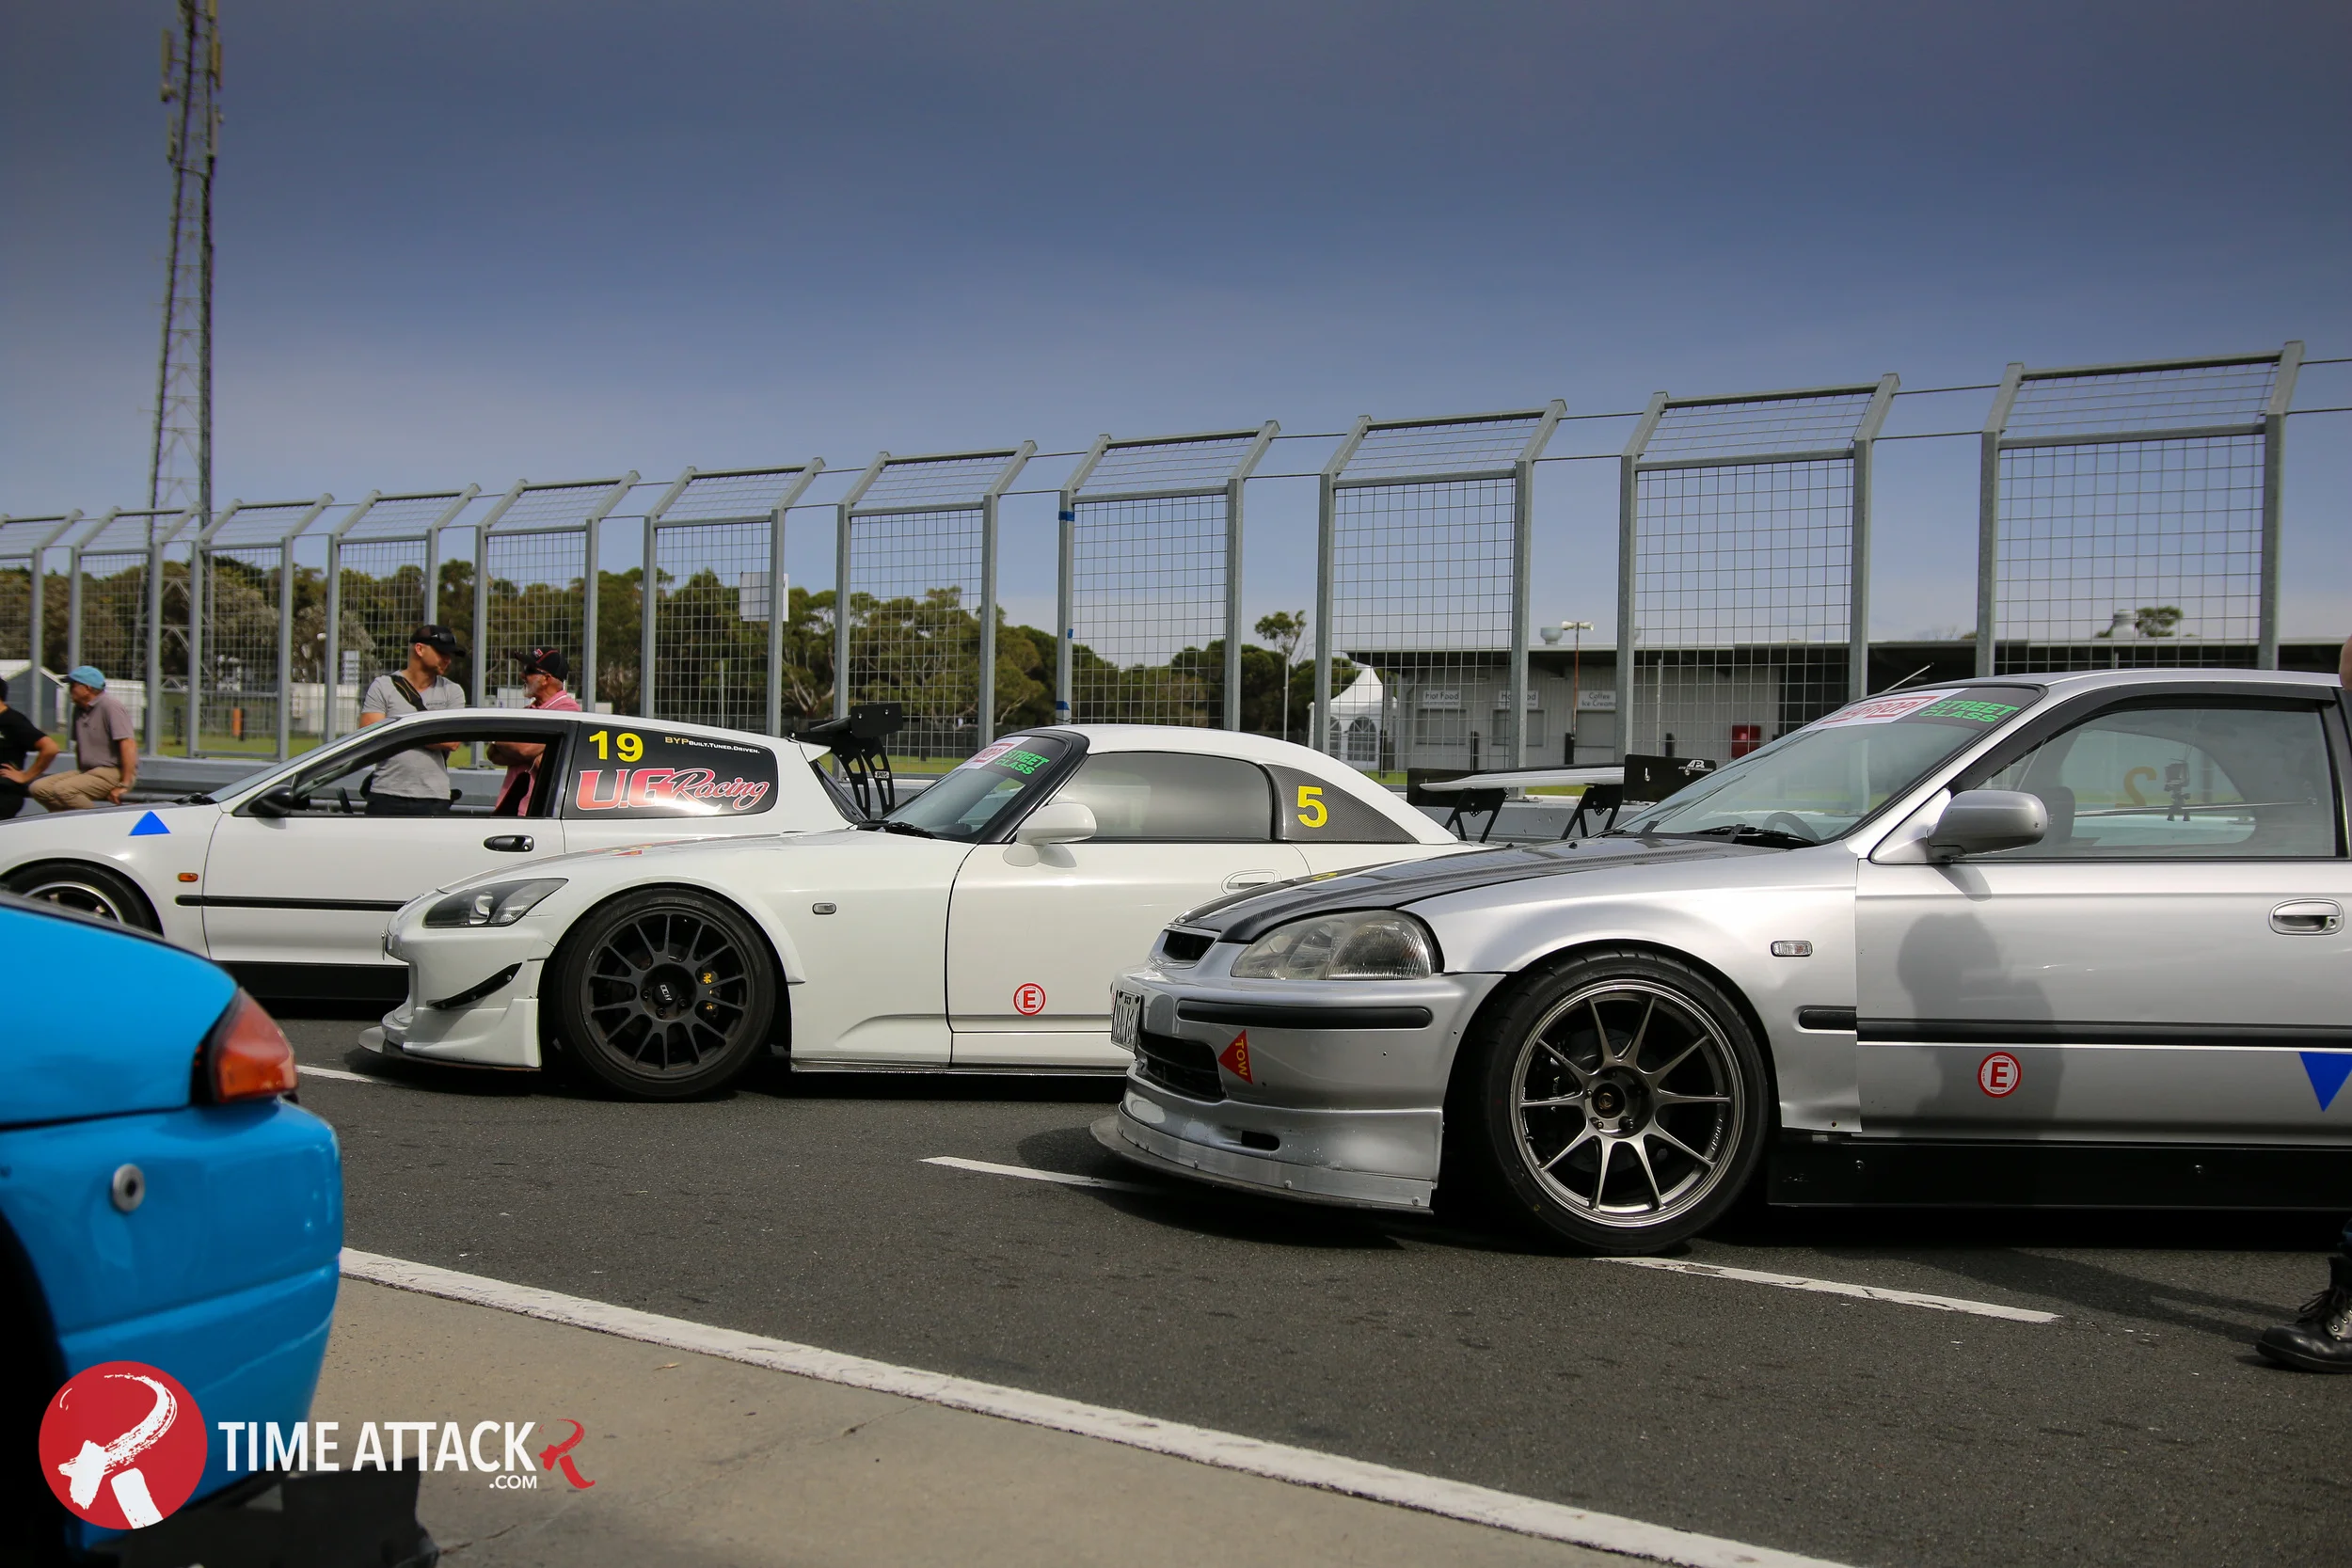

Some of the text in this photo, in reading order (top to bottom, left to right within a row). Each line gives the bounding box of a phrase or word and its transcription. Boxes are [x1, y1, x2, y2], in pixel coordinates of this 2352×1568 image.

[1588, 691, 1611, 700] Coffee
[1919, 709, 1998, 722] CLASS
[1931, 700, 2020, 716] STREET
[589, 730, 644, 762] 19
[664, 736, 689, 745] BYP
[994, 758, 1035, 775] CLASS
[1004, 749, 1050, 768] STREET
[669, 768, 770, 815] Racing
[1297, 785, 1328, 828] 5
[1024, 990, 1036, 1008] E
[1235, 1038, 1248, 1076] TOW
[1990, 1062, 2010, 1087] E
